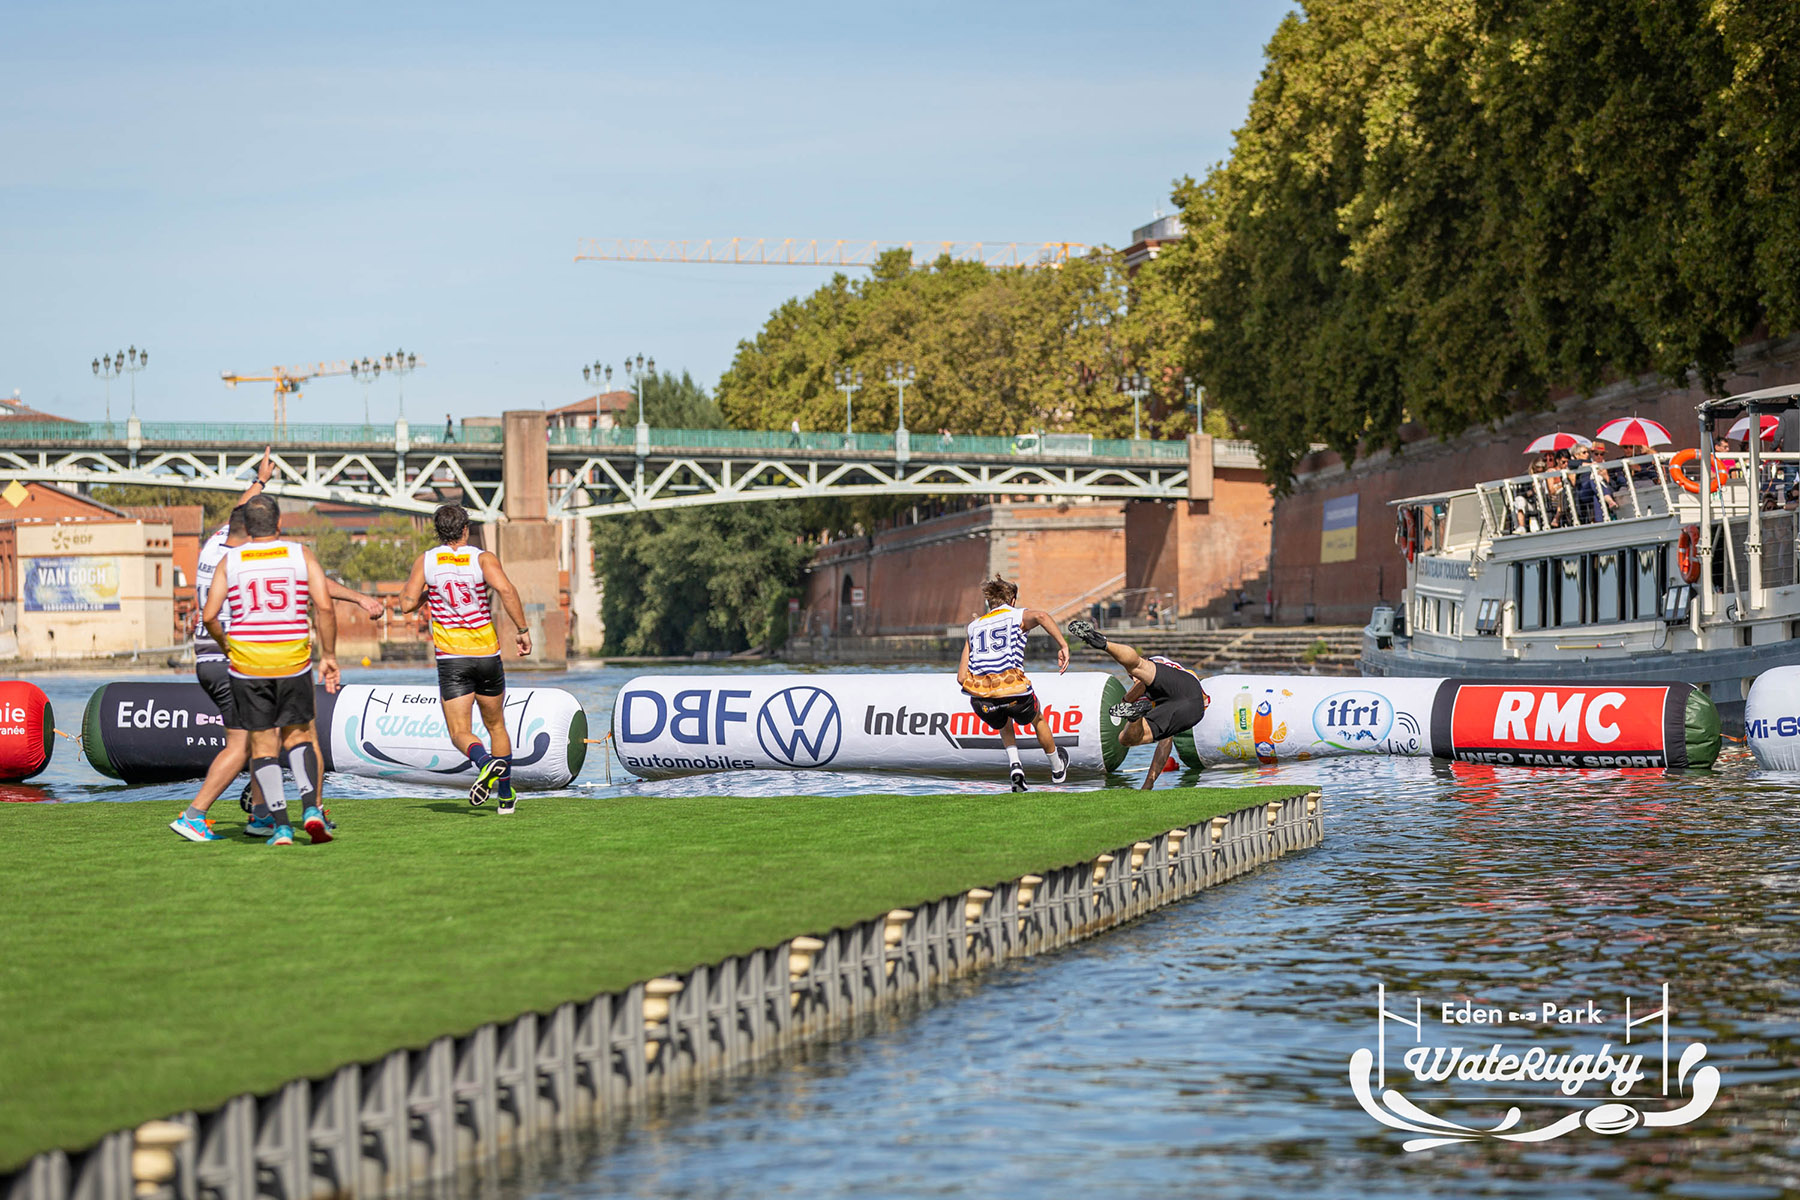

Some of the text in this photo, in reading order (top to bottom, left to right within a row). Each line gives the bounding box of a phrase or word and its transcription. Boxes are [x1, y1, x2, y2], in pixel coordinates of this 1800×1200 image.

[38, 567, 106, 587] VAN GOGH
[247, 578, 290, 612] 15
[975, 624, 1008, 654] 15
[402, 694, 437, 704] Eden
[0, 702, 26, 723] ie
[117, 699, 189, 728] Eden
[621, 689, 752, 745] DBF
[1327, 699, 1379, 726] ifri
[1493, 690, 1627, 743] RMC
[1745, 716, 1800, 738] Mi-G
[187, 736, 226, 747] PARI
[626, 754, 756, 769] automobiles
[1459, 752, 1662, 768] INFO TALK SPORT
